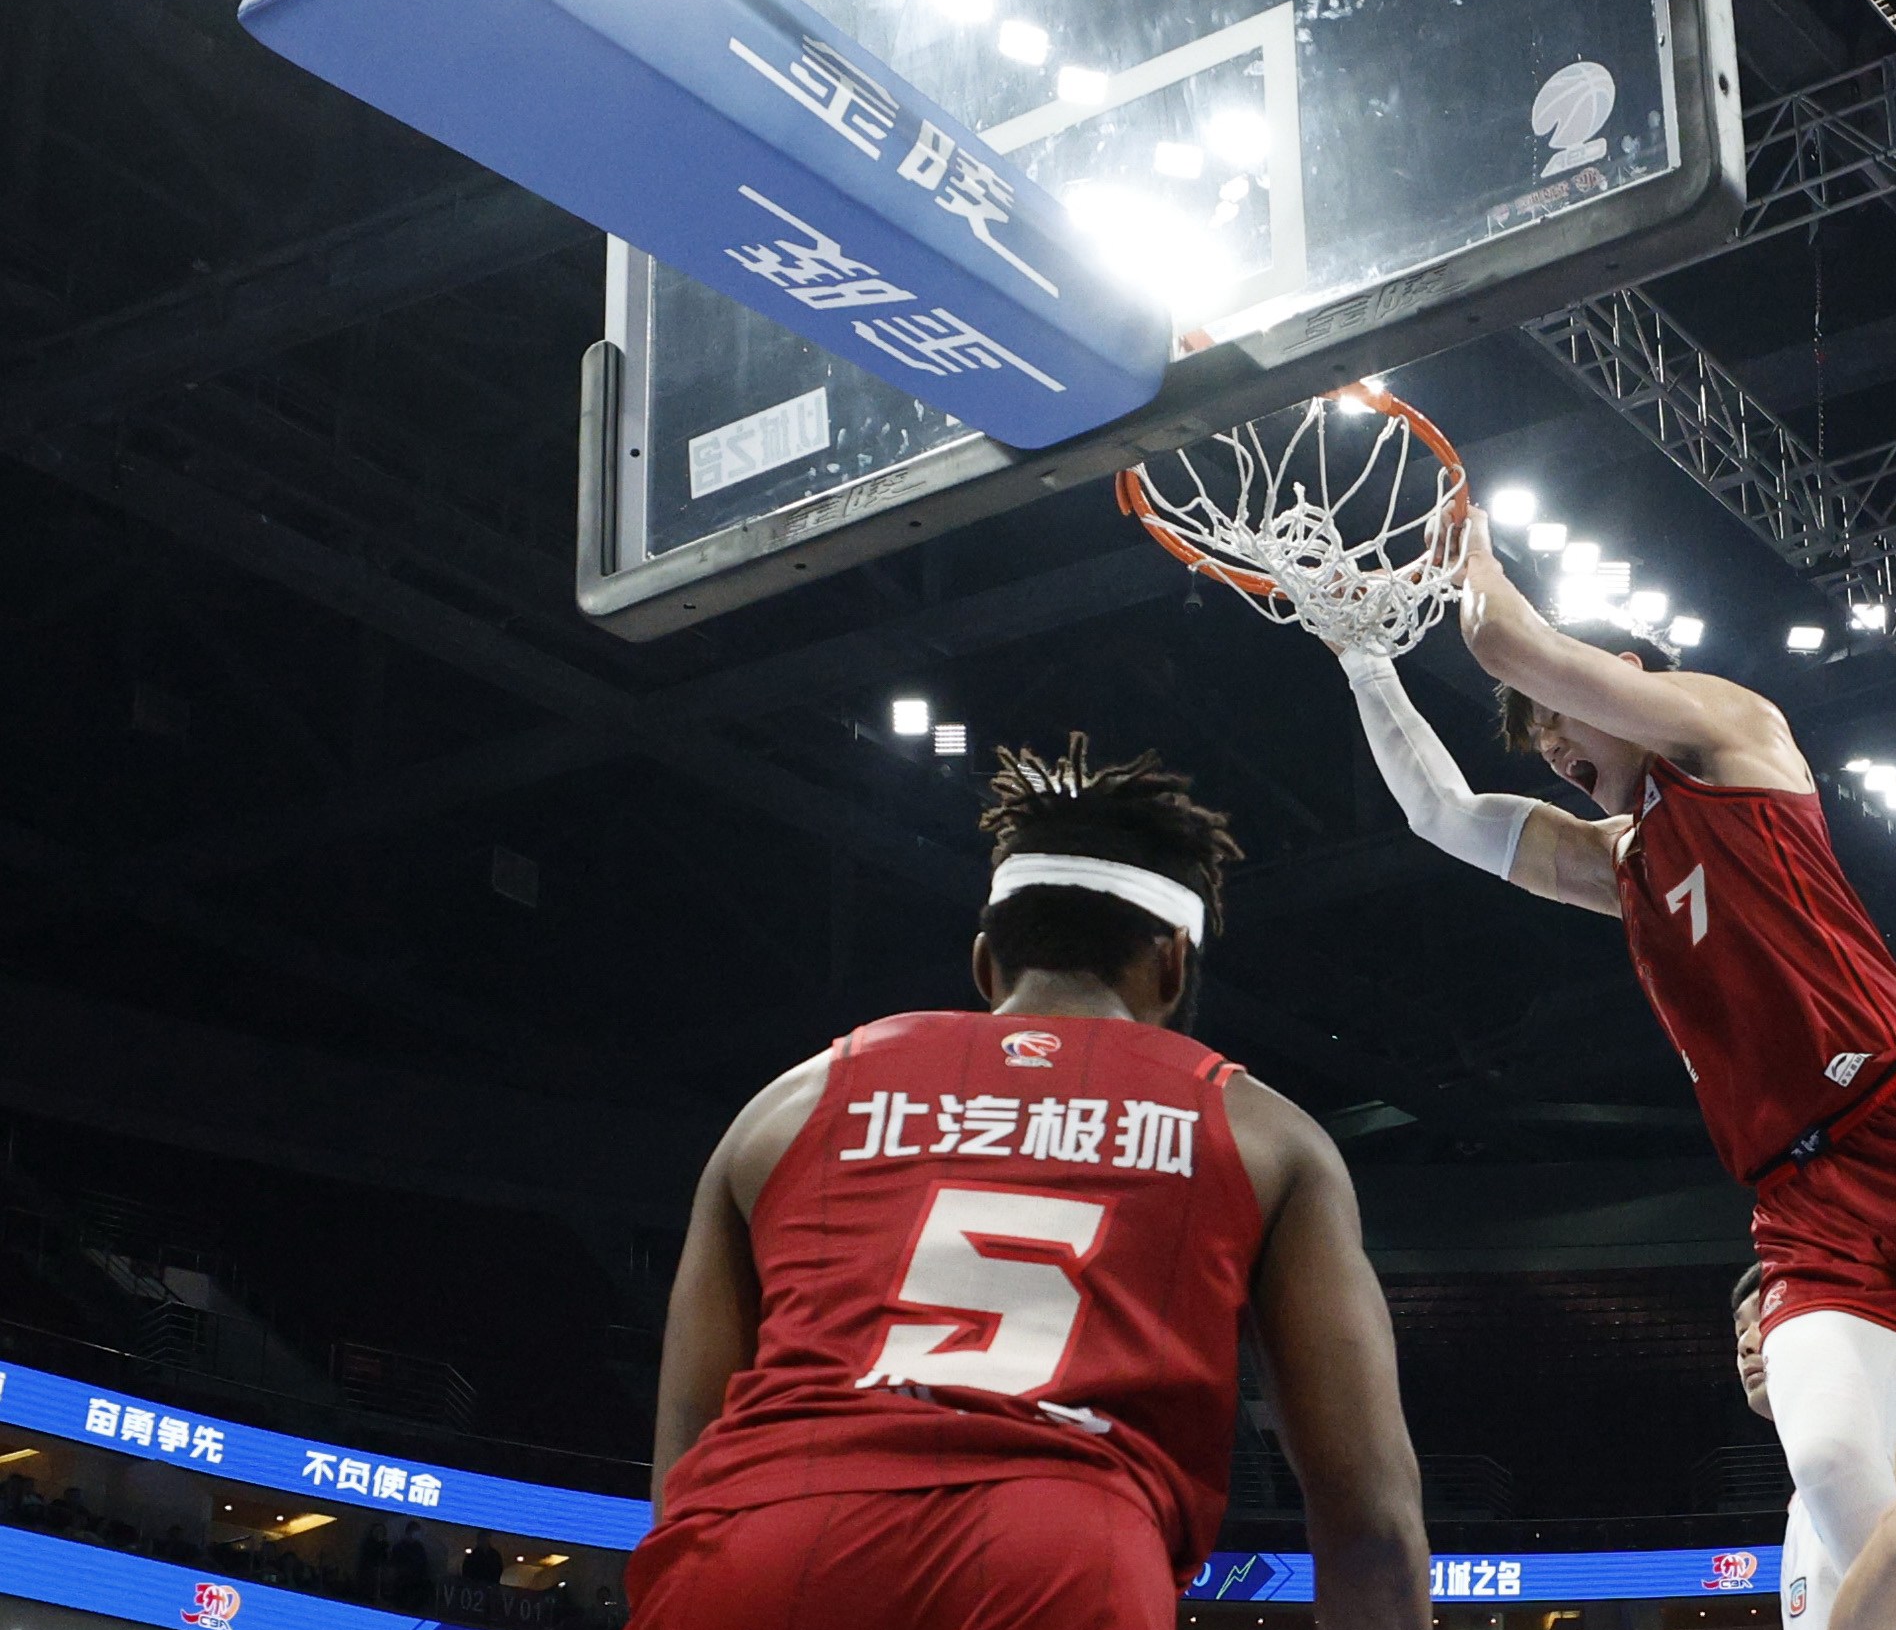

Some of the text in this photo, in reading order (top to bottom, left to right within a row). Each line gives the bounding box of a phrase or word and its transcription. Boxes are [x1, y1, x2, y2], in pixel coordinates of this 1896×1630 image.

[1666, 863, 1707, 946] 7
[840, 1091, 1200, 1178] 北汽极狐
[875, 1186, 1108, 1396] 5
[85, 1397, 442, 1507] 奋勇争先 不负使命
